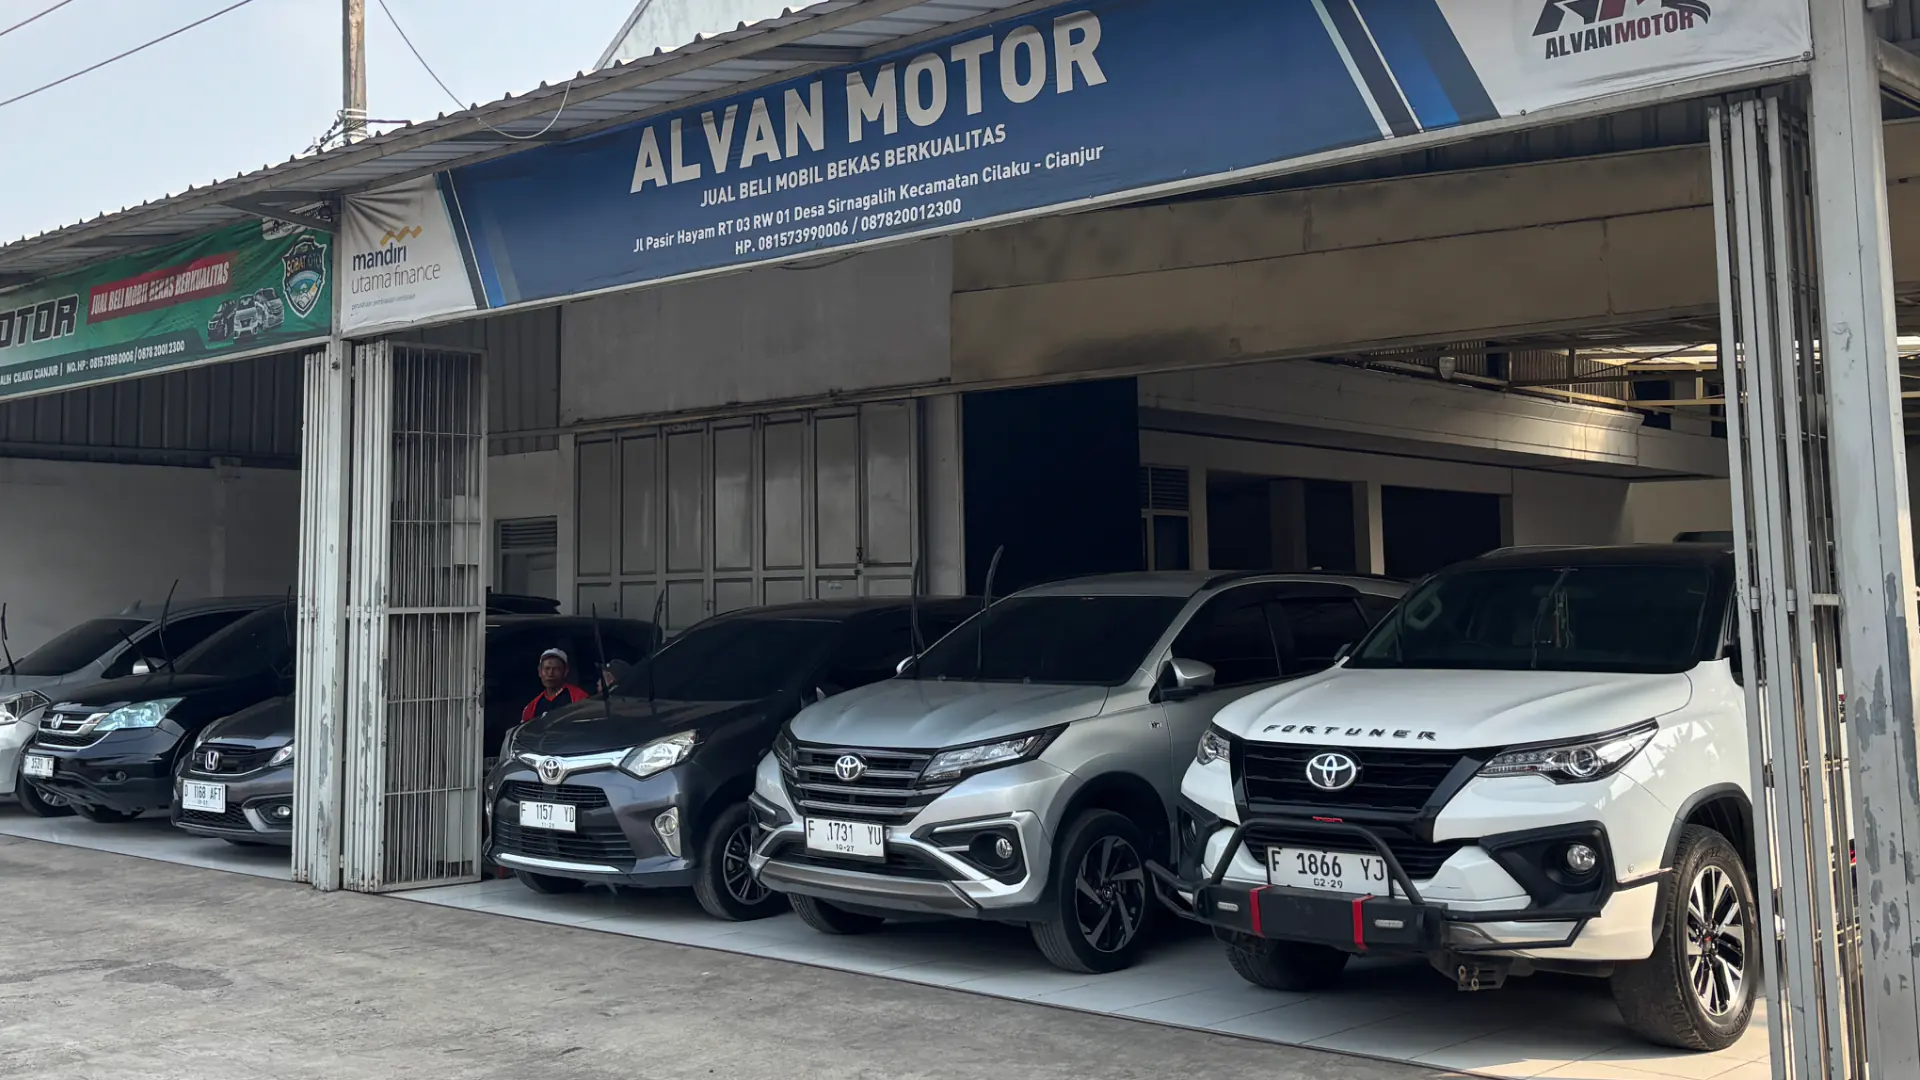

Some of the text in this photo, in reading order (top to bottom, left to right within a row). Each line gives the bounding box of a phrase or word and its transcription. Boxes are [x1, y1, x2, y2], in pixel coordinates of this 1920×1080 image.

[630, 9, 1107, 193] ALVAN MOTOR
[701, 124, 1006, 207] JUAL BELI MOBIL BEKAS BERKUALITAS
[646, 233, 674, 249] Pasir
[677, 227, 715, 245] Hayam
[718, 220, 733, 236] RT
[736, 217, 751, 232] 03
[753, 212, 773, 229] RW
[776, 209, 790, 225] 01
[794, 204, 825, 221] Desa
[827, 187, 896, 213] Sirnagalih
[900, 173, 978, 200] Kecamatan
[982, 161, 1030, 183] Cilaku
[1045, 145, 1104, 170] Cianjur
[735, 240, 755, 255] HP.
[758, 223, 849, 251] 081573990006
[861, 198, 962, 232] 087820012300
[353, 242, 407, 271] mandiri
[91, 261, 230, 315] JUAL BELI MOBIL BEKAS BERKUALITAS
[351, 263, 441, 294] utama finance
[13, 370, 33, 383] CILAKU
[34, 365, 58, 380] CIANJUR
[1263, 724, 1437, 741] FORTUNER
[521, 803, 575, 823] F 1157 YD
[808, 820, 881, 845] F 1731 YU
[1271, 850, 1385, 881] F 1866 YJ
